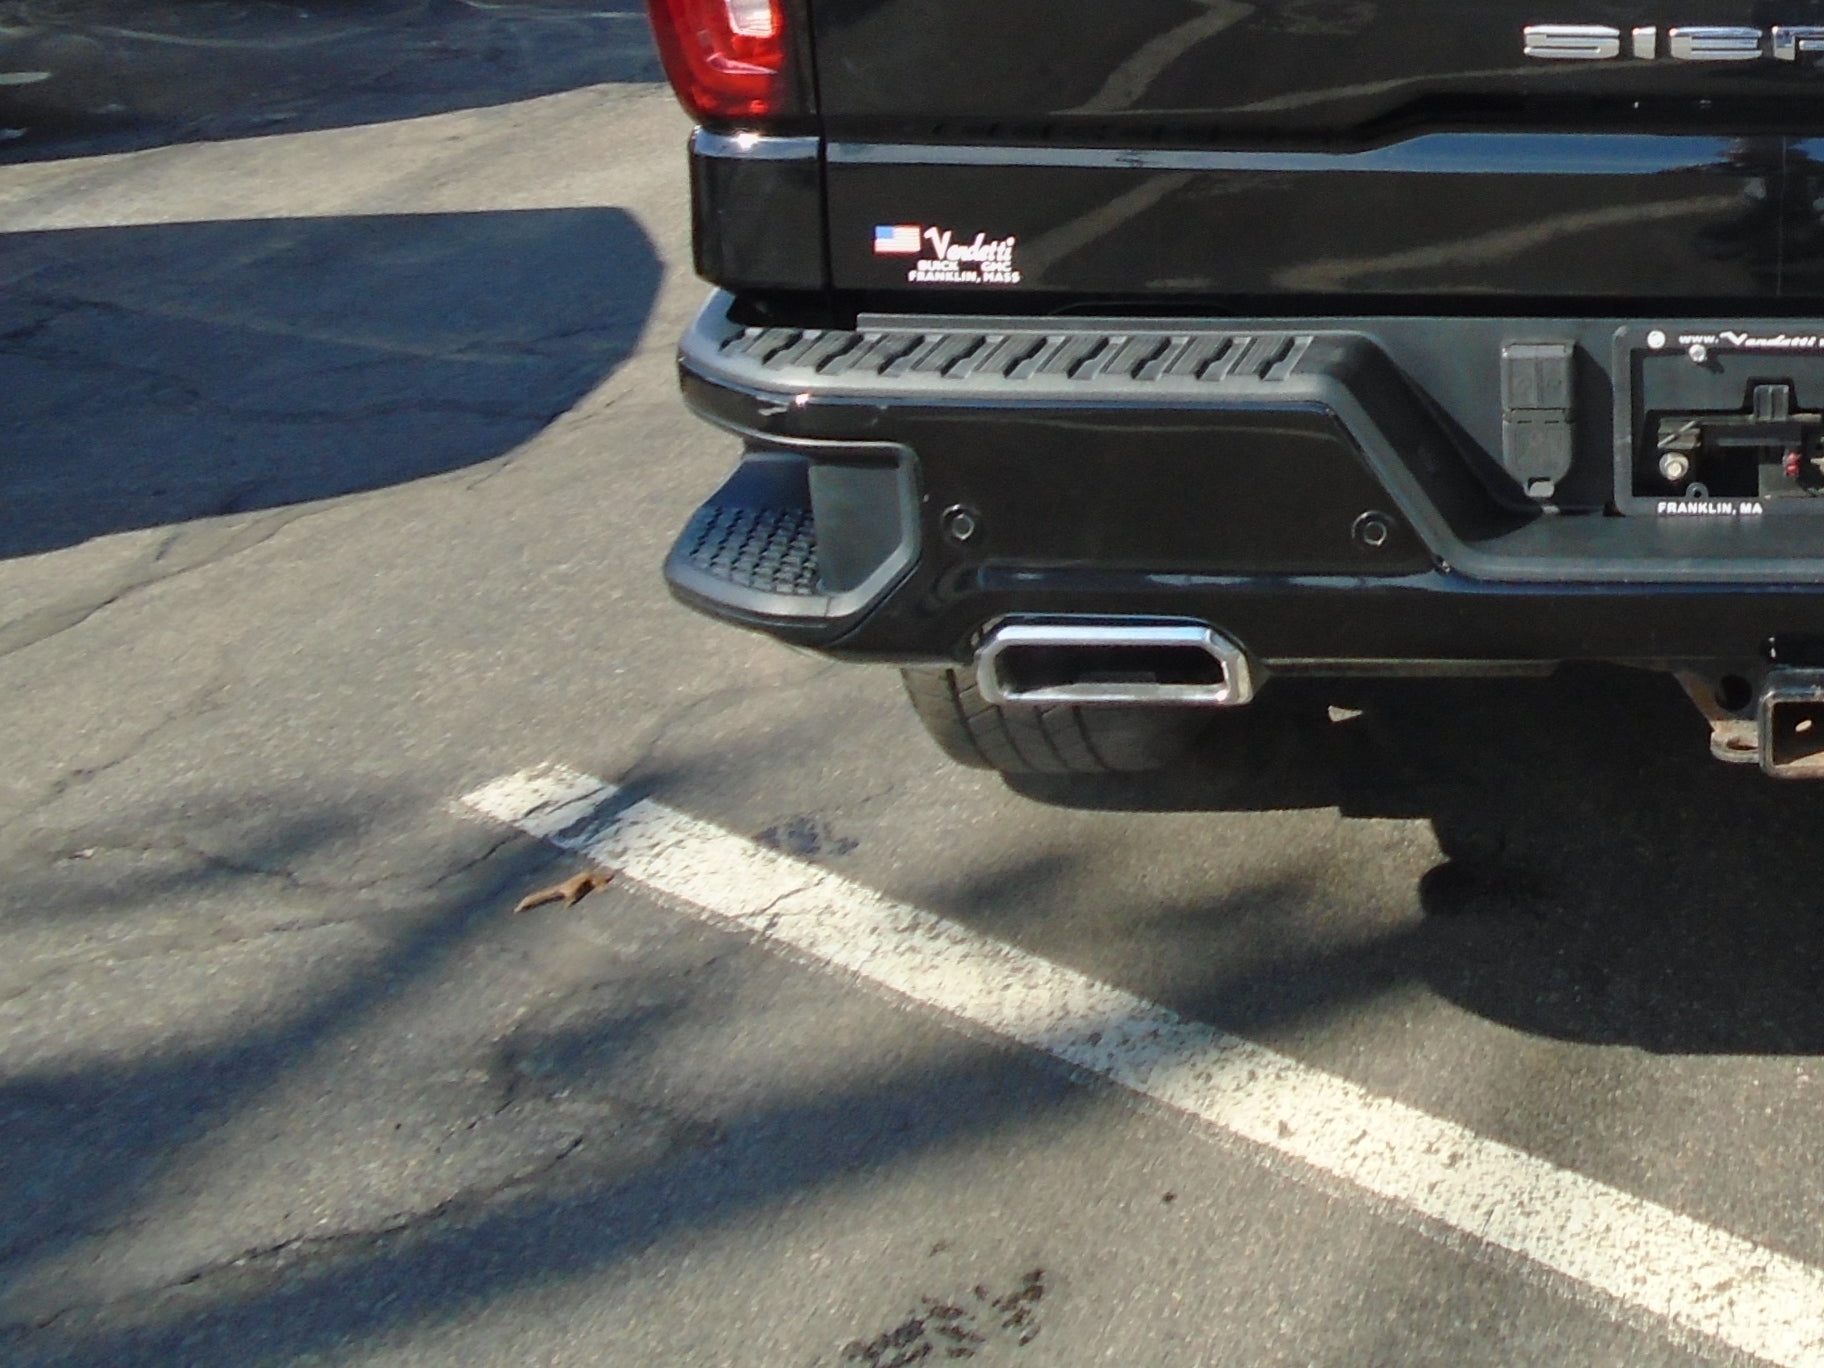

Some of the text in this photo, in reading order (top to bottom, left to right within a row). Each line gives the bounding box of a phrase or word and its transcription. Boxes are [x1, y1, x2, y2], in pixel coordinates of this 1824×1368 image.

[923, 227, 1015, 261] Vendetti
[981, 261, 1012, 272] GMC
[1740, 502, 1763, 514] MA
